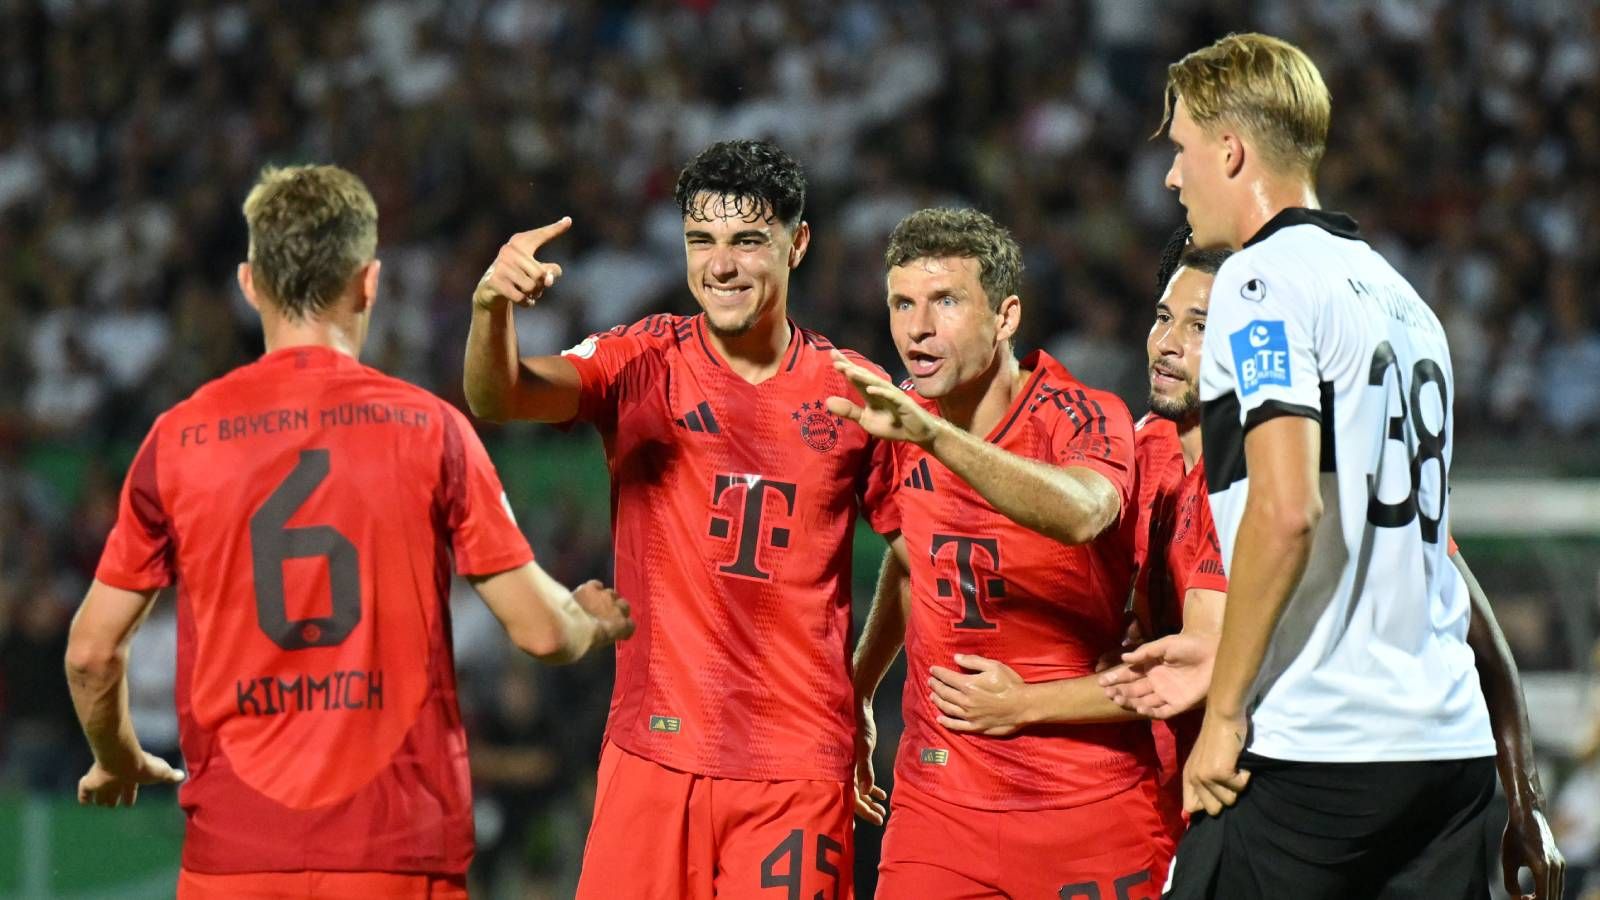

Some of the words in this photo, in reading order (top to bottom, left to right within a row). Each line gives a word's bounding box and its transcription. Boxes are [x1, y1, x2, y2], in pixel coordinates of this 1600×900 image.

[180, 423, 208, 448] FC
[218, 408, 309, 442] BAYERN
[1366, 339, 1447, 544] 38
[249, 448, 362, 651] 6
[709, 474, 797, 580] T
[931, 533, 1005, 630] T
[235, 670, 384, 716] KIMMICH
[760, 828, 843, 900] 45
